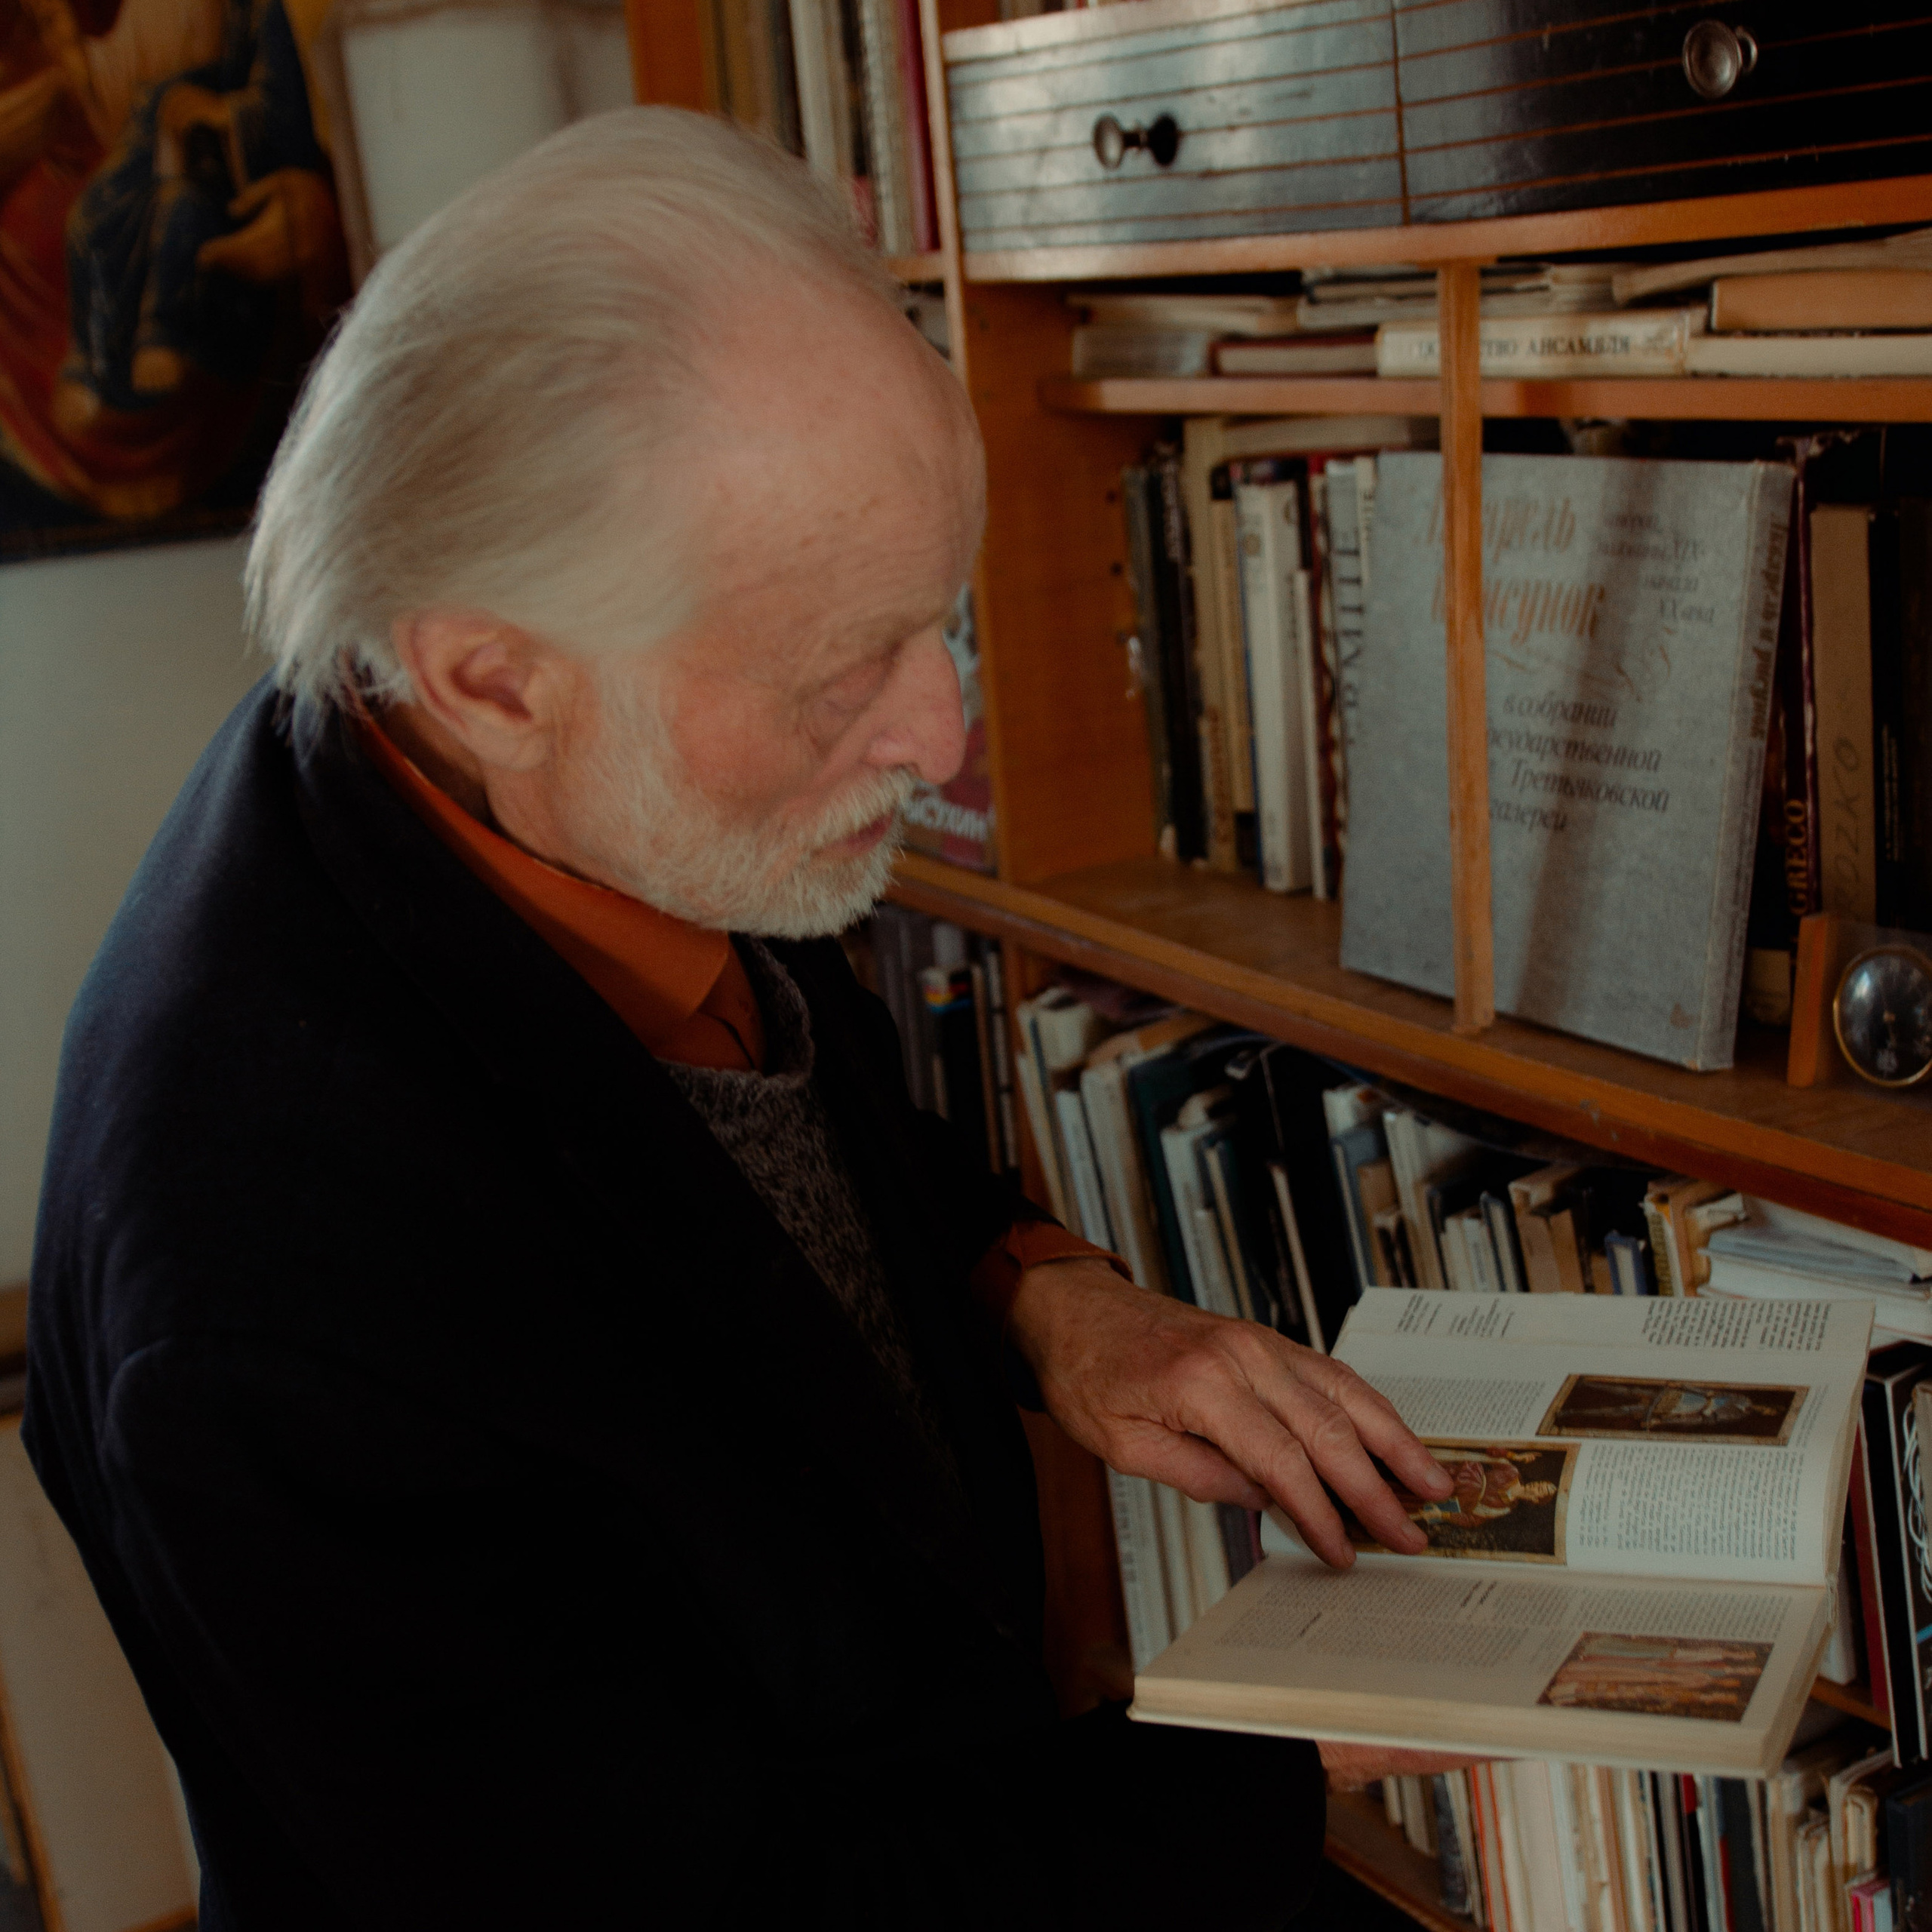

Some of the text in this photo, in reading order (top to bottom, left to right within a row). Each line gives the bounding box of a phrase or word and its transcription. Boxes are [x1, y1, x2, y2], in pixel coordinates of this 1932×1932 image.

[1517, 691, 1618, 729] собрании
[1509, 757, 1671, 814] Третьяковской
[1783, 798, 1808, 916] GRECO
